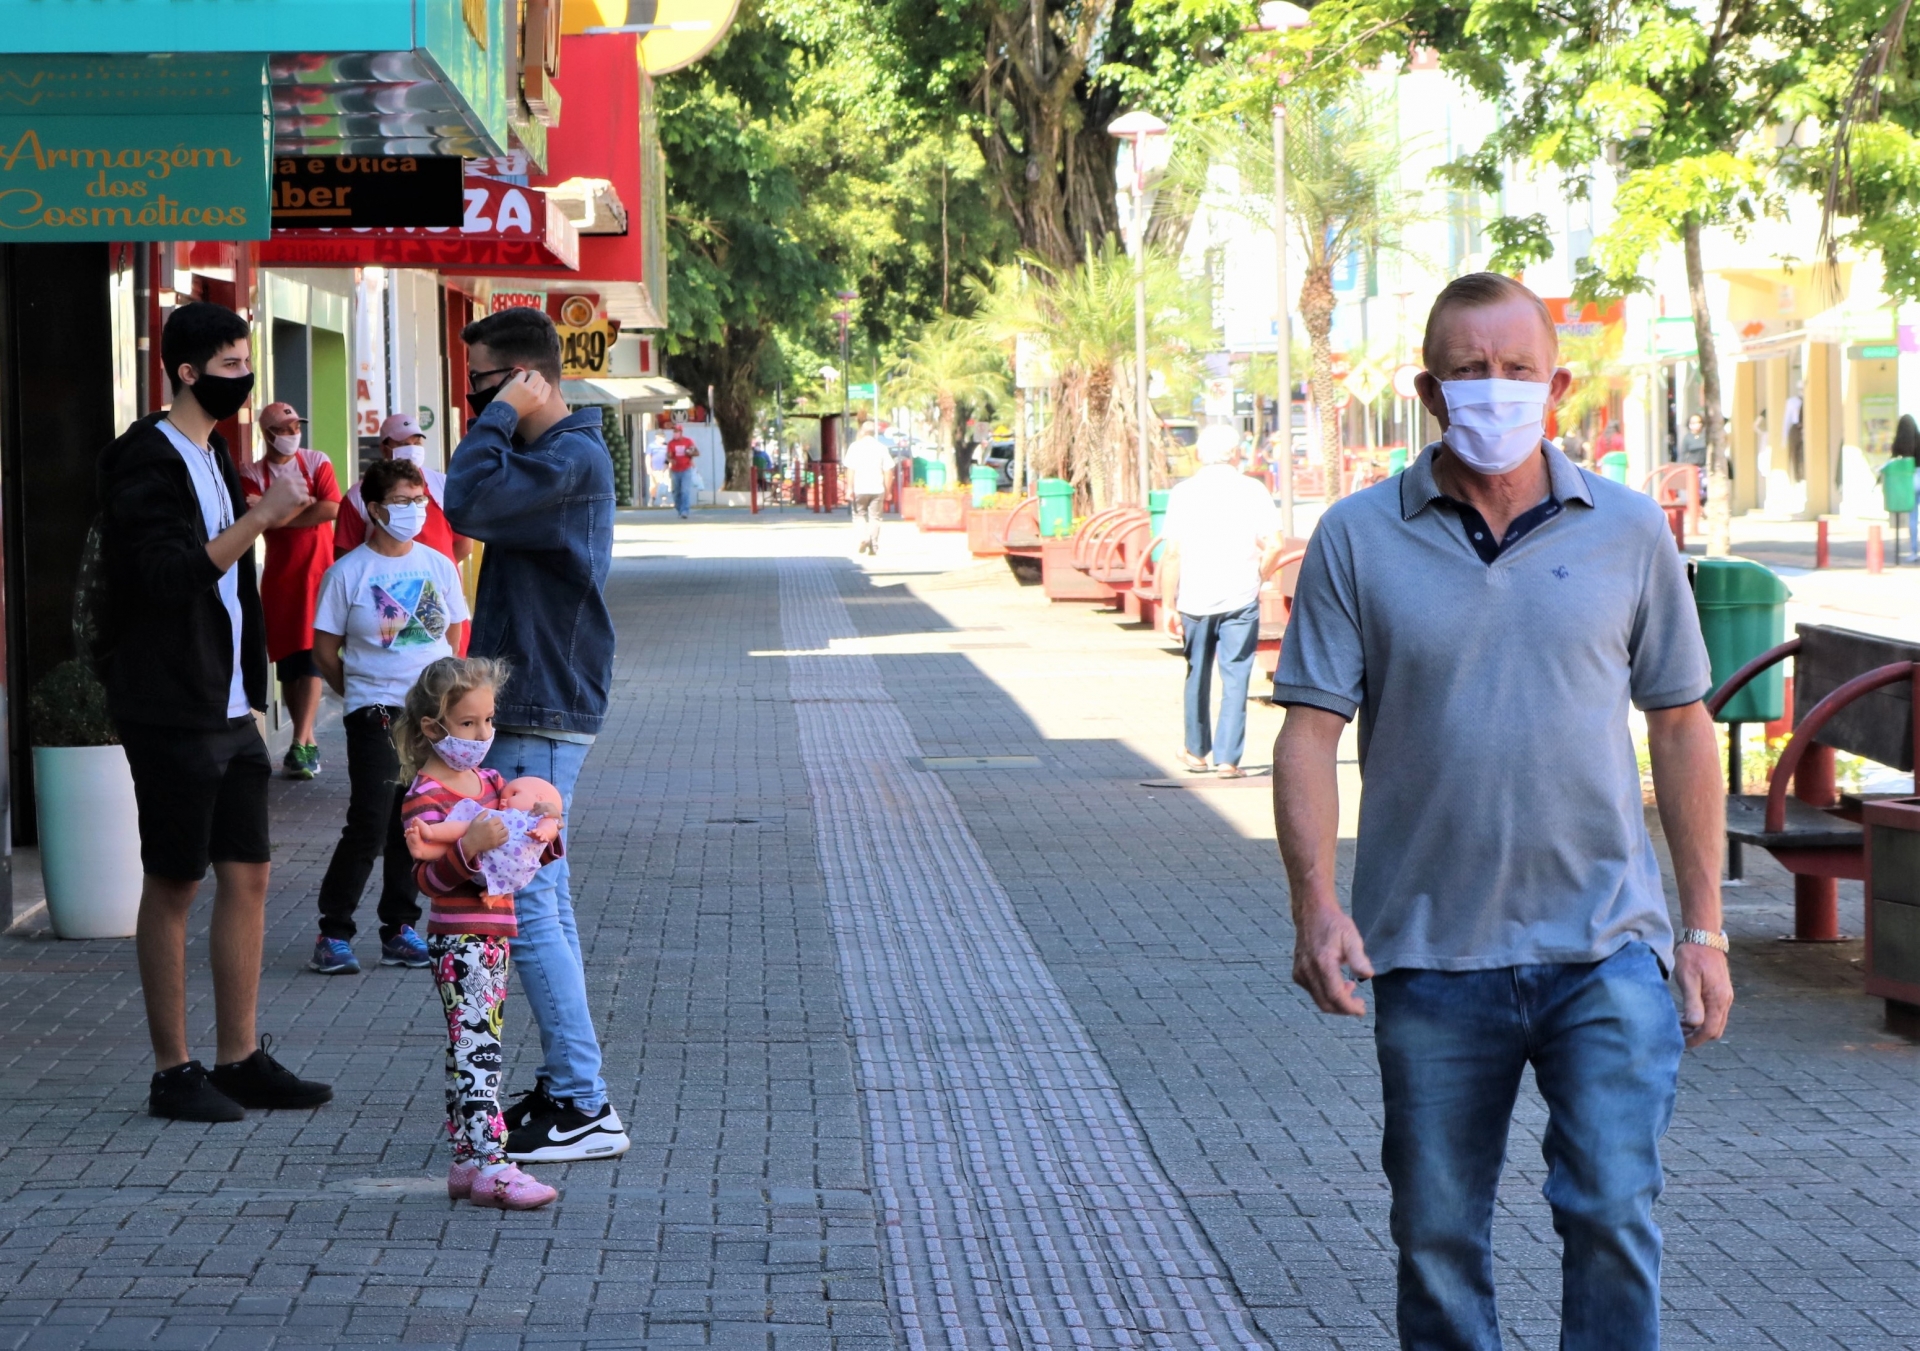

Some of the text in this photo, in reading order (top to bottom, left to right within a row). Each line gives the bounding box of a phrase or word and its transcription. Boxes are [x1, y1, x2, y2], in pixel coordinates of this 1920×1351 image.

[0, 130, 241, 178] Armazém
[307, 159, 325, 174] e
[86, 170, 148, 198] dos
[272, 181, 352, 208] ber
[0, 188, 247, 230] Cosméticos
